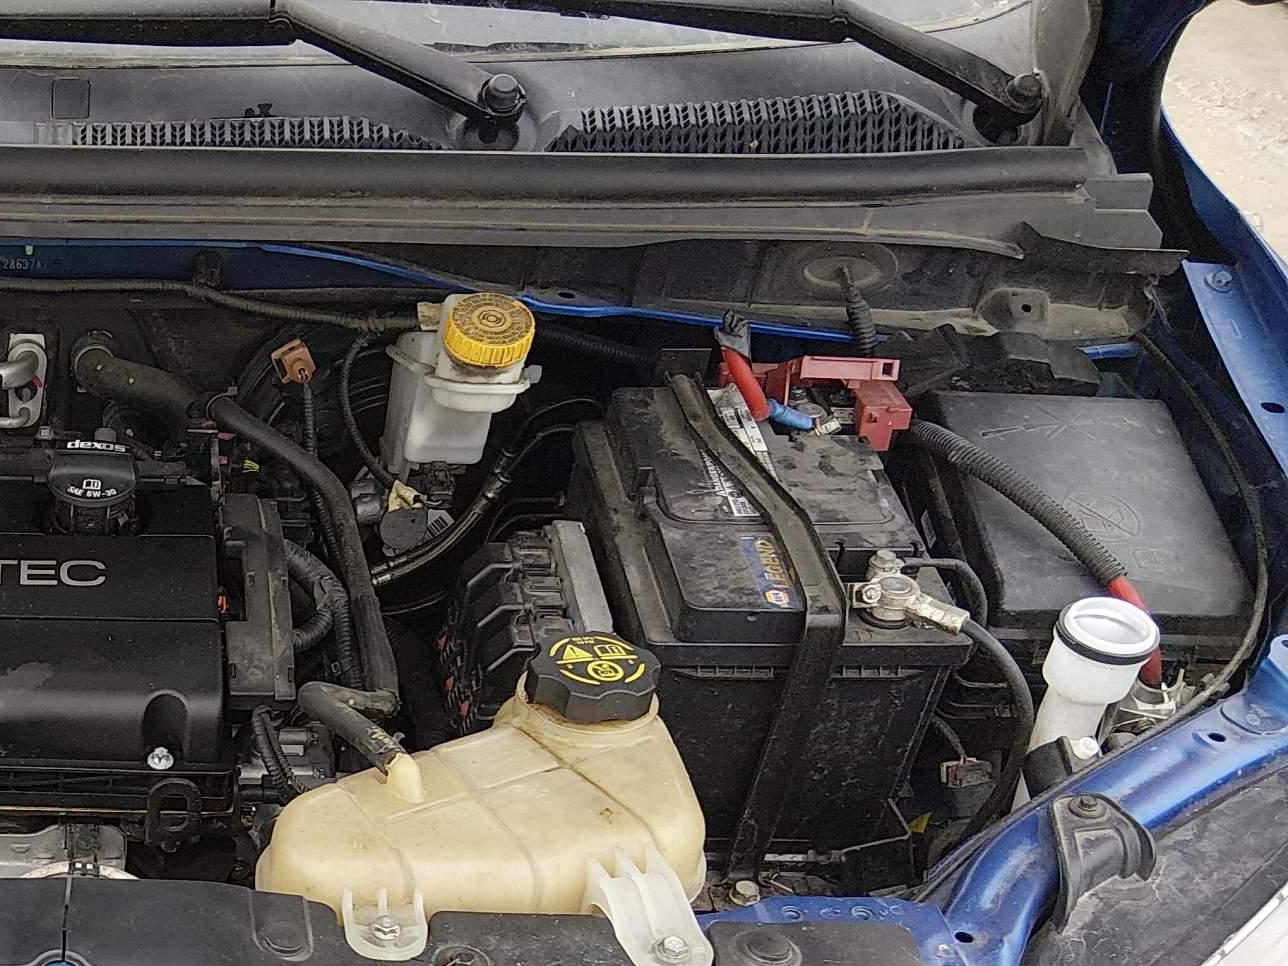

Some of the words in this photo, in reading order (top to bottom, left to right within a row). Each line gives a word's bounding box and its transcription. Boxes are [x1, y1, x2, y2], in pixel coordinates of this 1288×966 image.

[67, 439, 126, 452] dexos
[67, 486, 84, 496] SAE
[86, 488, 117, 498] 5W-30
[755, 537, 793, 588] LEGEND
